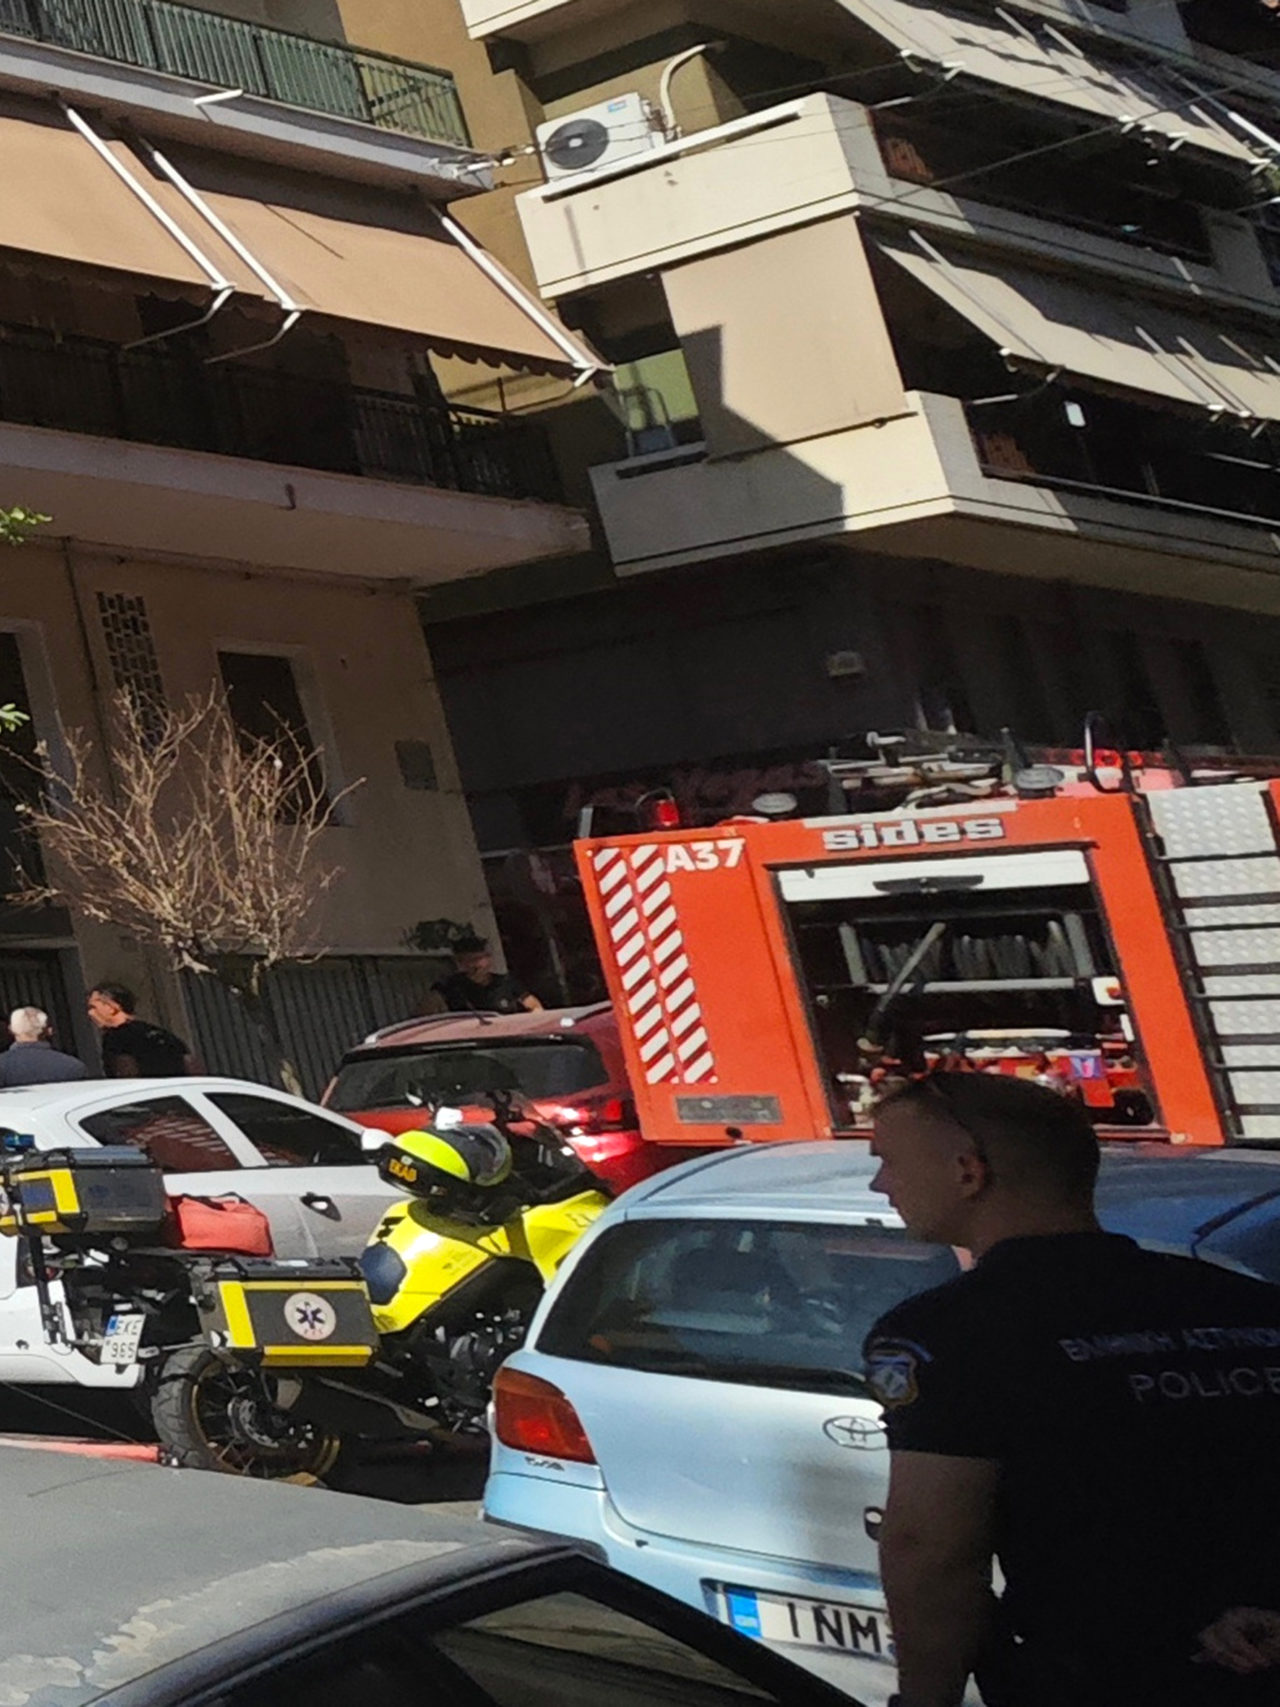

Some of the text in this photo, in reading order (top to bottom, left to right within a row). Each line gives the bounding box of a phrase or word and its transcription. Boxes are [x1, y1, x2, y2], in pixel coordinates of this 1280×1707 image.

[822, 817, 1005, 852] sides
[663, 837, 746, 874] A37
[1127, 1366, 1280, 1403] POLICE
